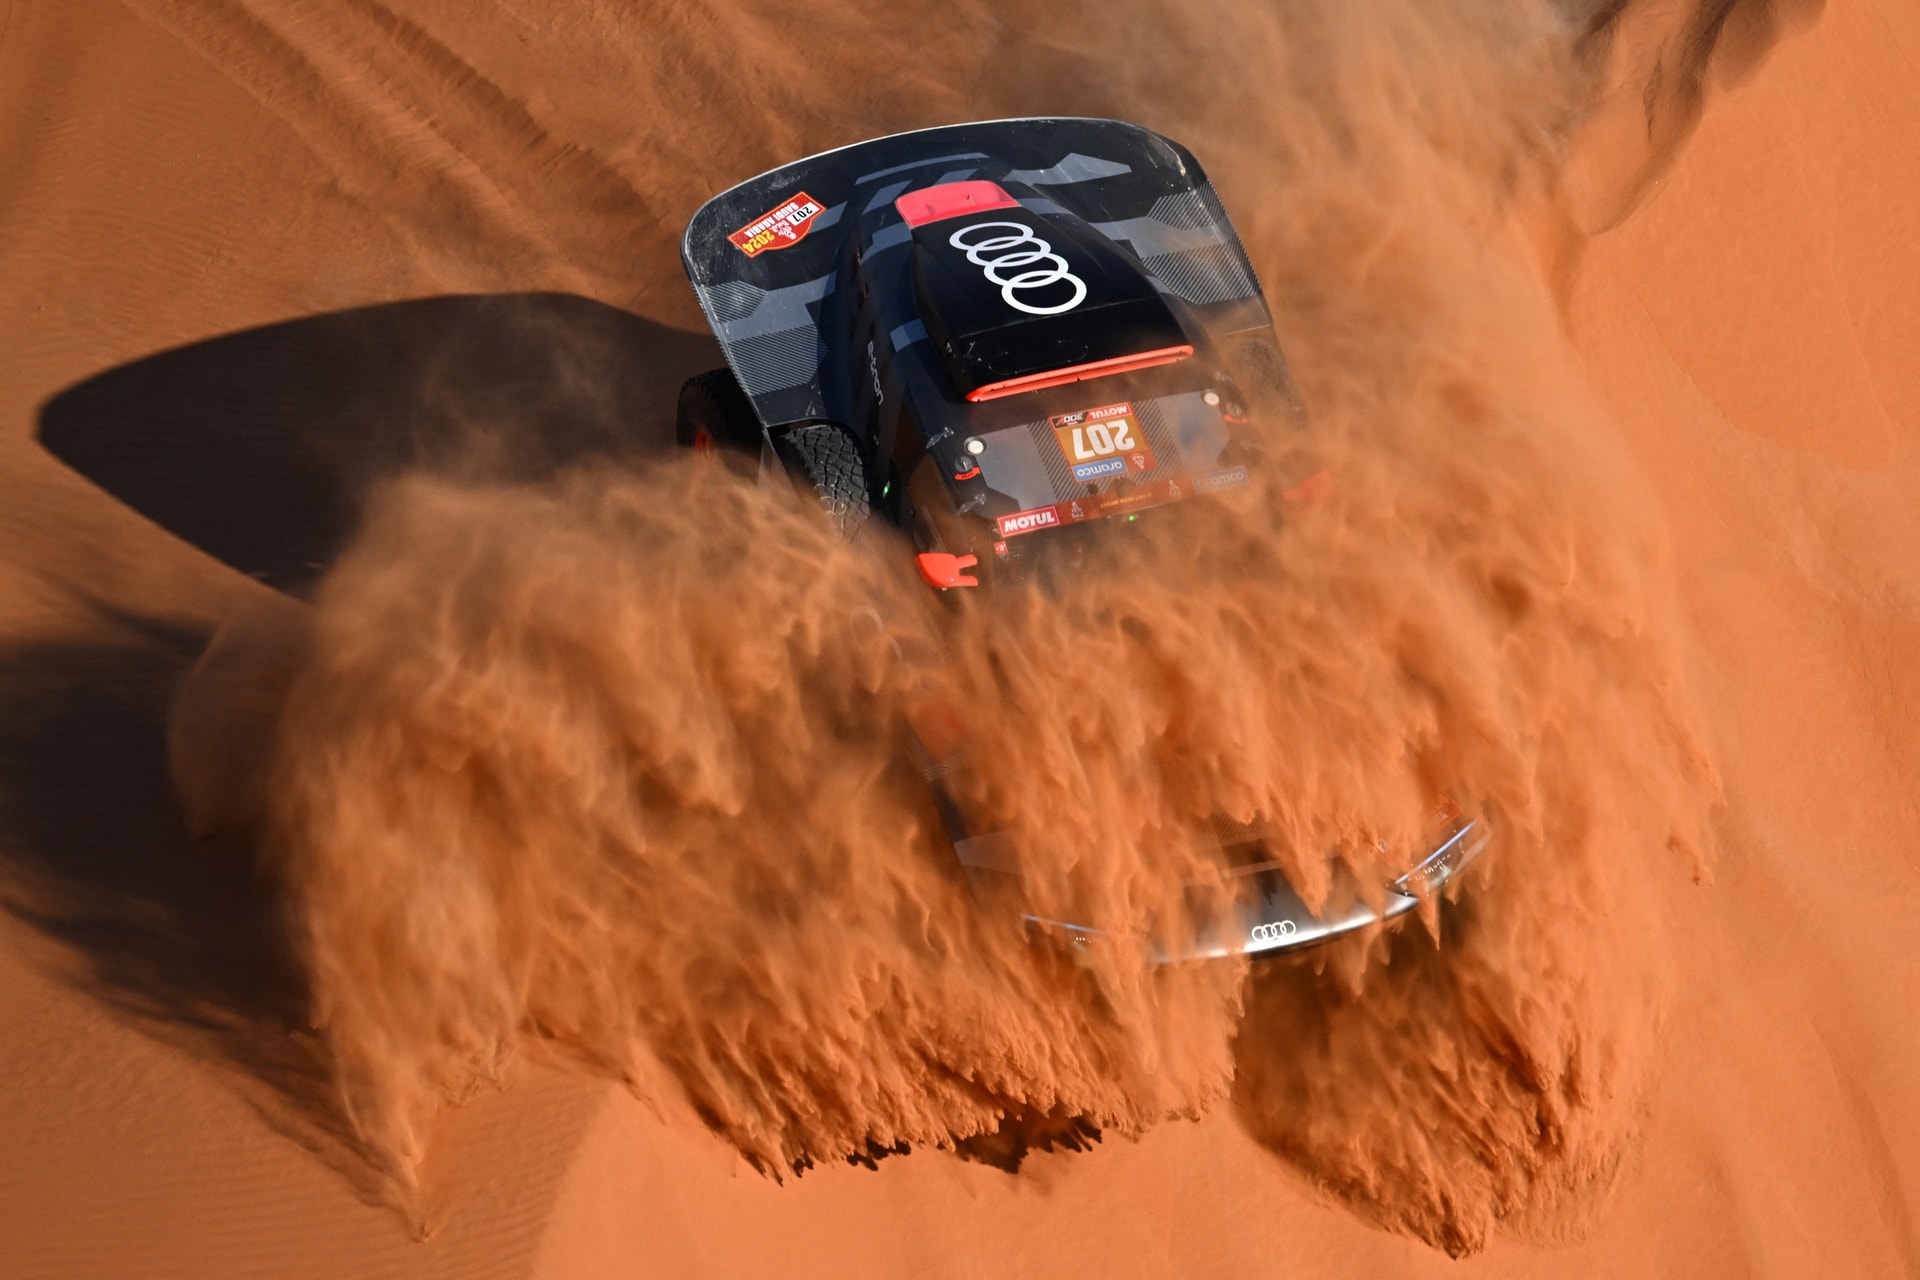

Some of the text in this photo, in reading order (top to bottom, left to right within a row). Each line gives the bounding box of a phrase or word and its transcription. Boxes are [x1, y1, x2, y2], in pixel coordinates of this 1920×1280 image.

[773, 202, 799, 221] SAUDI
[792, 206, 813, 223] 207
[744, 216, 775, 238] ARABIA
[742, 230, 775, 253] 2024
[868, 340, 884, 405] e-tron
[1090, 405, 1127, 419] MOTUL
[1072, 419, 1135, 460] 207
[1077, 461, 1123, 477] aramco
[1004, 511, 1055, 533] MOTUL
